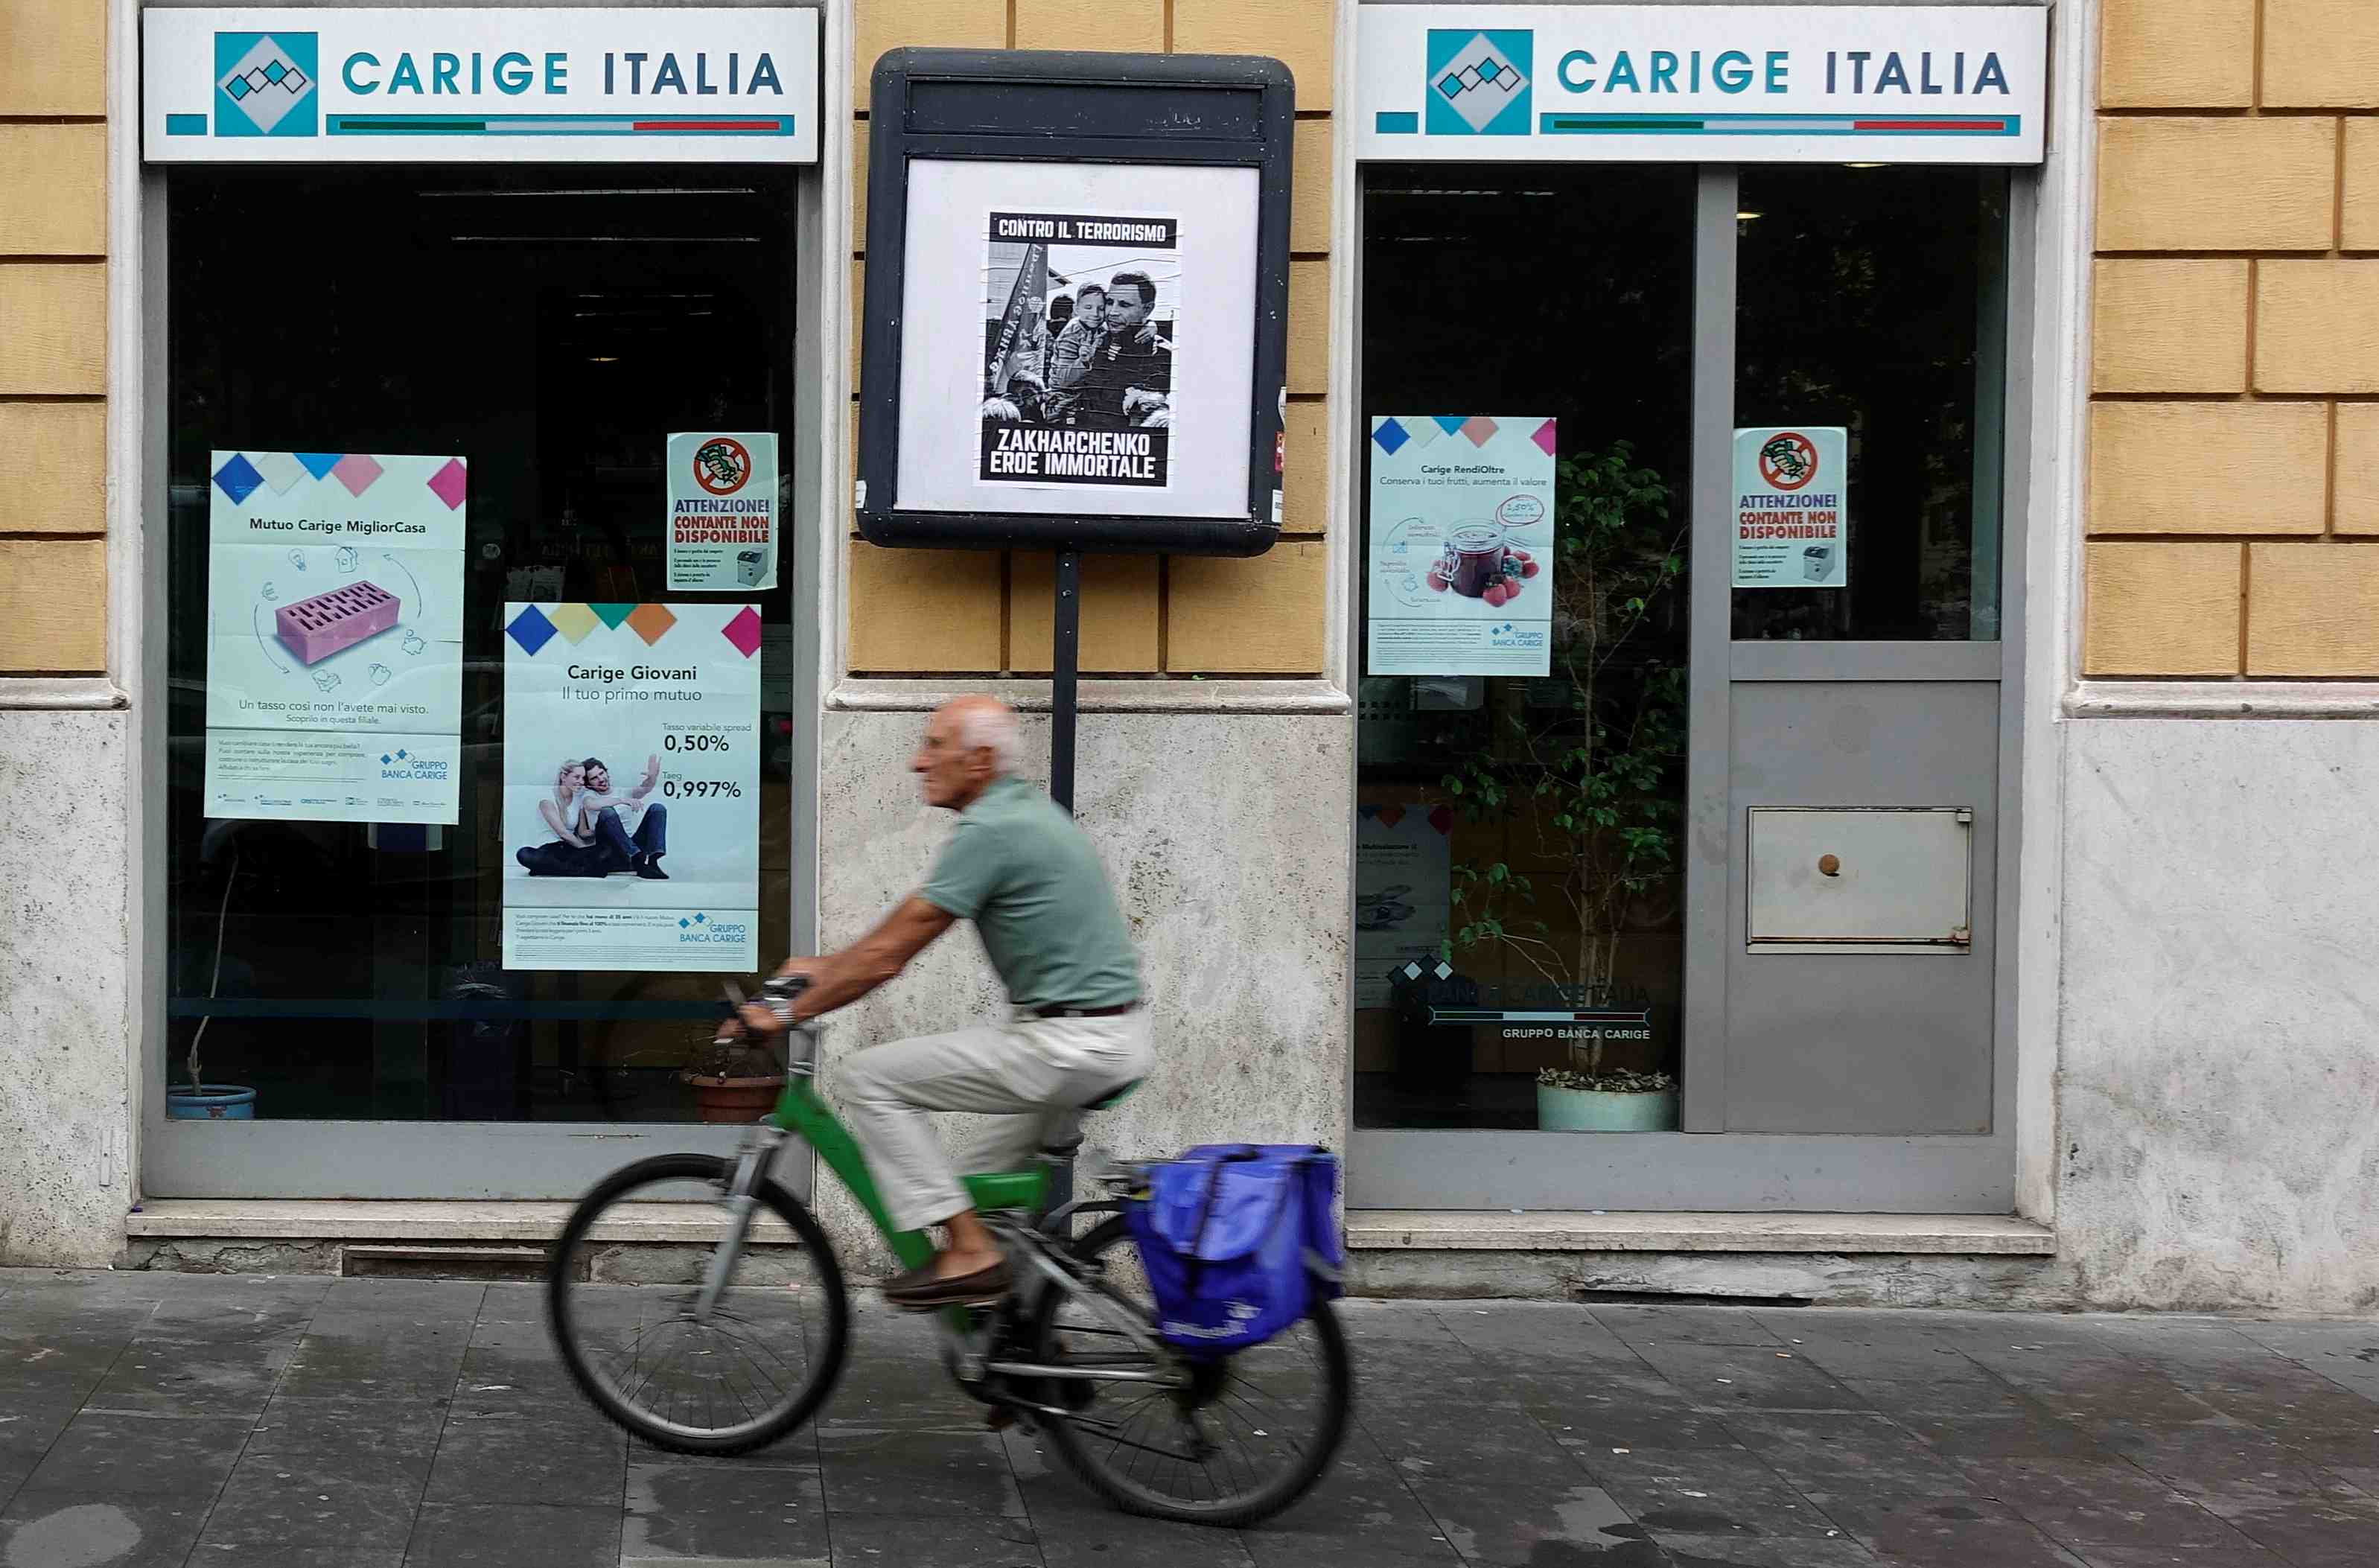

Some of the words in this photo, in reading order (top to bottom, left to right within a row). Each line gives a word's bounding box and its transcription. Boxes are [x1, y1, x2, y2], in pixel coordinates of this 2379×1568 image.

[343, 52, 568, 95] CARIGE
[605, 52, 783, 95] ITALIA
[1557, 50, 1789, 94] CARIGE
[1827, 52, 2010, 95] ITALIA
[999, 219, 1054, 238] CONTRO
[1059, 221, 1071, 239] IL
[1077, 222, 1166, 242] TERRORISMO
[997, 429, 1150, 456] ZAKHARCHENKO
[990, 451, 1038, 475] EROE
[1044, 453, 1156, 479] IMMORTALE
[1421, 465, 1451, 476] Carige
[1454, 465, 1505, 474] RendiOltre
[1379, 477, 1420, 485] Conserva
[1448, 477, 1470, 486] frutti,
[1513, 477, 1517, 485] il
[1521, 478, 1547, 486] valore
[674, 500, 769, 513] ATTENZIONE!
[1739, 494, 1837, 508] ATTENZIONE!
[674, 516, 736, 529] CONTANTE
[742, 516, 768, 529] NON
[1739, 511, 1802, 524] CONTANTE
[1808, 511, 1836, 524] NON
[249, 518, 293, 529] Mutuo
[298, 519, 342, 534] Carige
[346, 520, 426, 535] MigliorCasa
[1739, 526, 1836, 539] DISPONIBILE
[675, 529, 768, 543] DISPONIBILE
[1517, 639, 1543, 647] CARIGE
[567, 665, 624, 683] Carige
[631, 666, 696, 680] Giovani
[563, 686, 570, 699] Il
[576, 689, 600, 700] tuo
[605, 687, 649, 704] primo
[654, 689, 702, 701] mutuo
[239, 700, 254, 710] Un
[258, 701, 285, 710] tasso
[313, 703, 334, 712] non
[377, 703, 397, 713] mai
[401, 704, 429, 714] visto.
[286, 715, 318, 724] Scoprilo
[330, 716, 356, 725] questa
[687, 723, 721, 731] variabile
[724, 724, 751, 733] spread
[664, 735, 729, 753] 0,50%
[412, 761, 448, 770] GRUPPO
[381, 770, 413, 779] BANCA
[415, 771, 448, 780] CARIGE
[662, 771, 682, 781] Taeg
[663, 781, 741, 799] 0,997%
[710, 924, 745, 933] GRUPPO
[680, 934, 710, 943] BANCA
[713, 934, 745, 943] CARIGE
[1503, 1028, 1553, 1039] GRUPPO
[1558, 1029, 1600, 1039] BANCA
[1605, 1029, 1651, 1039] CARIGE
